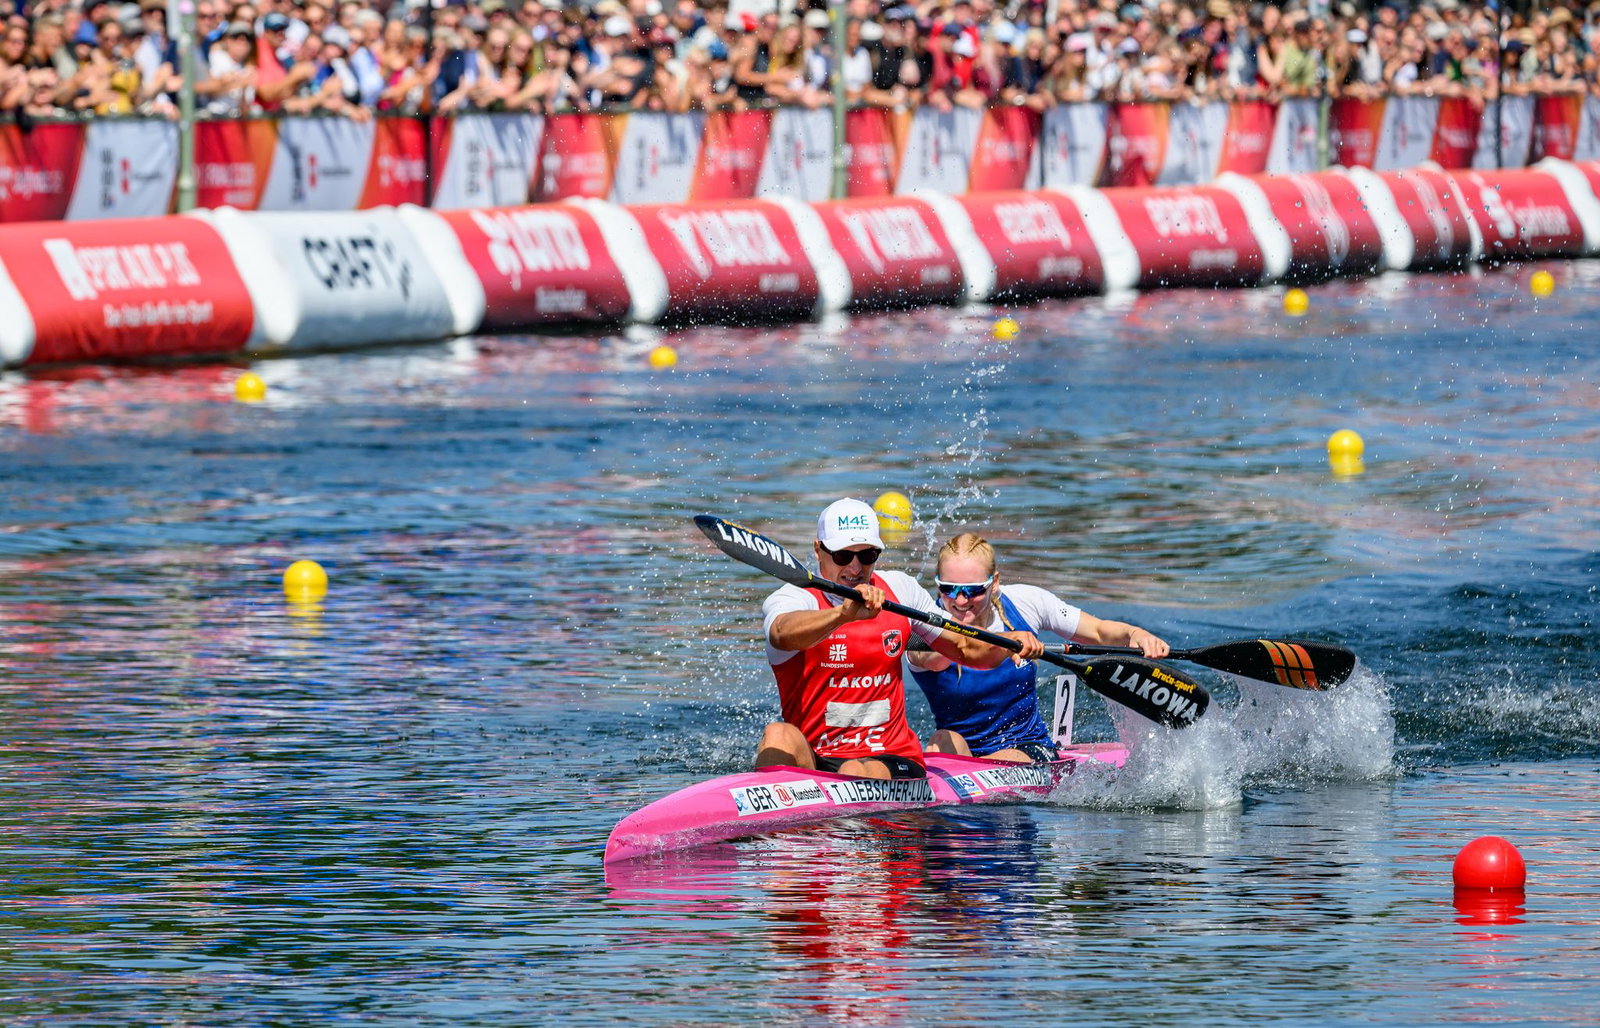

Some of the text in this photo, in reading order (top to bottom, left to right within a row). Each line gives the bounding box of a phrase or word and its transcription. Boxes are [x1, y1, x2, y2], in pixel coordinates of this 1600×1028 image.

[838, 515, 869, 526] M4E
[716, 523, 796, 569] LAKOWA
[829, 673, 892, 689] LAKOWA
[1109, 665, 1198, 721] LAKOWA
[1058, 680, 1070, 736] 2
[745, 786, 778, 812] GER
